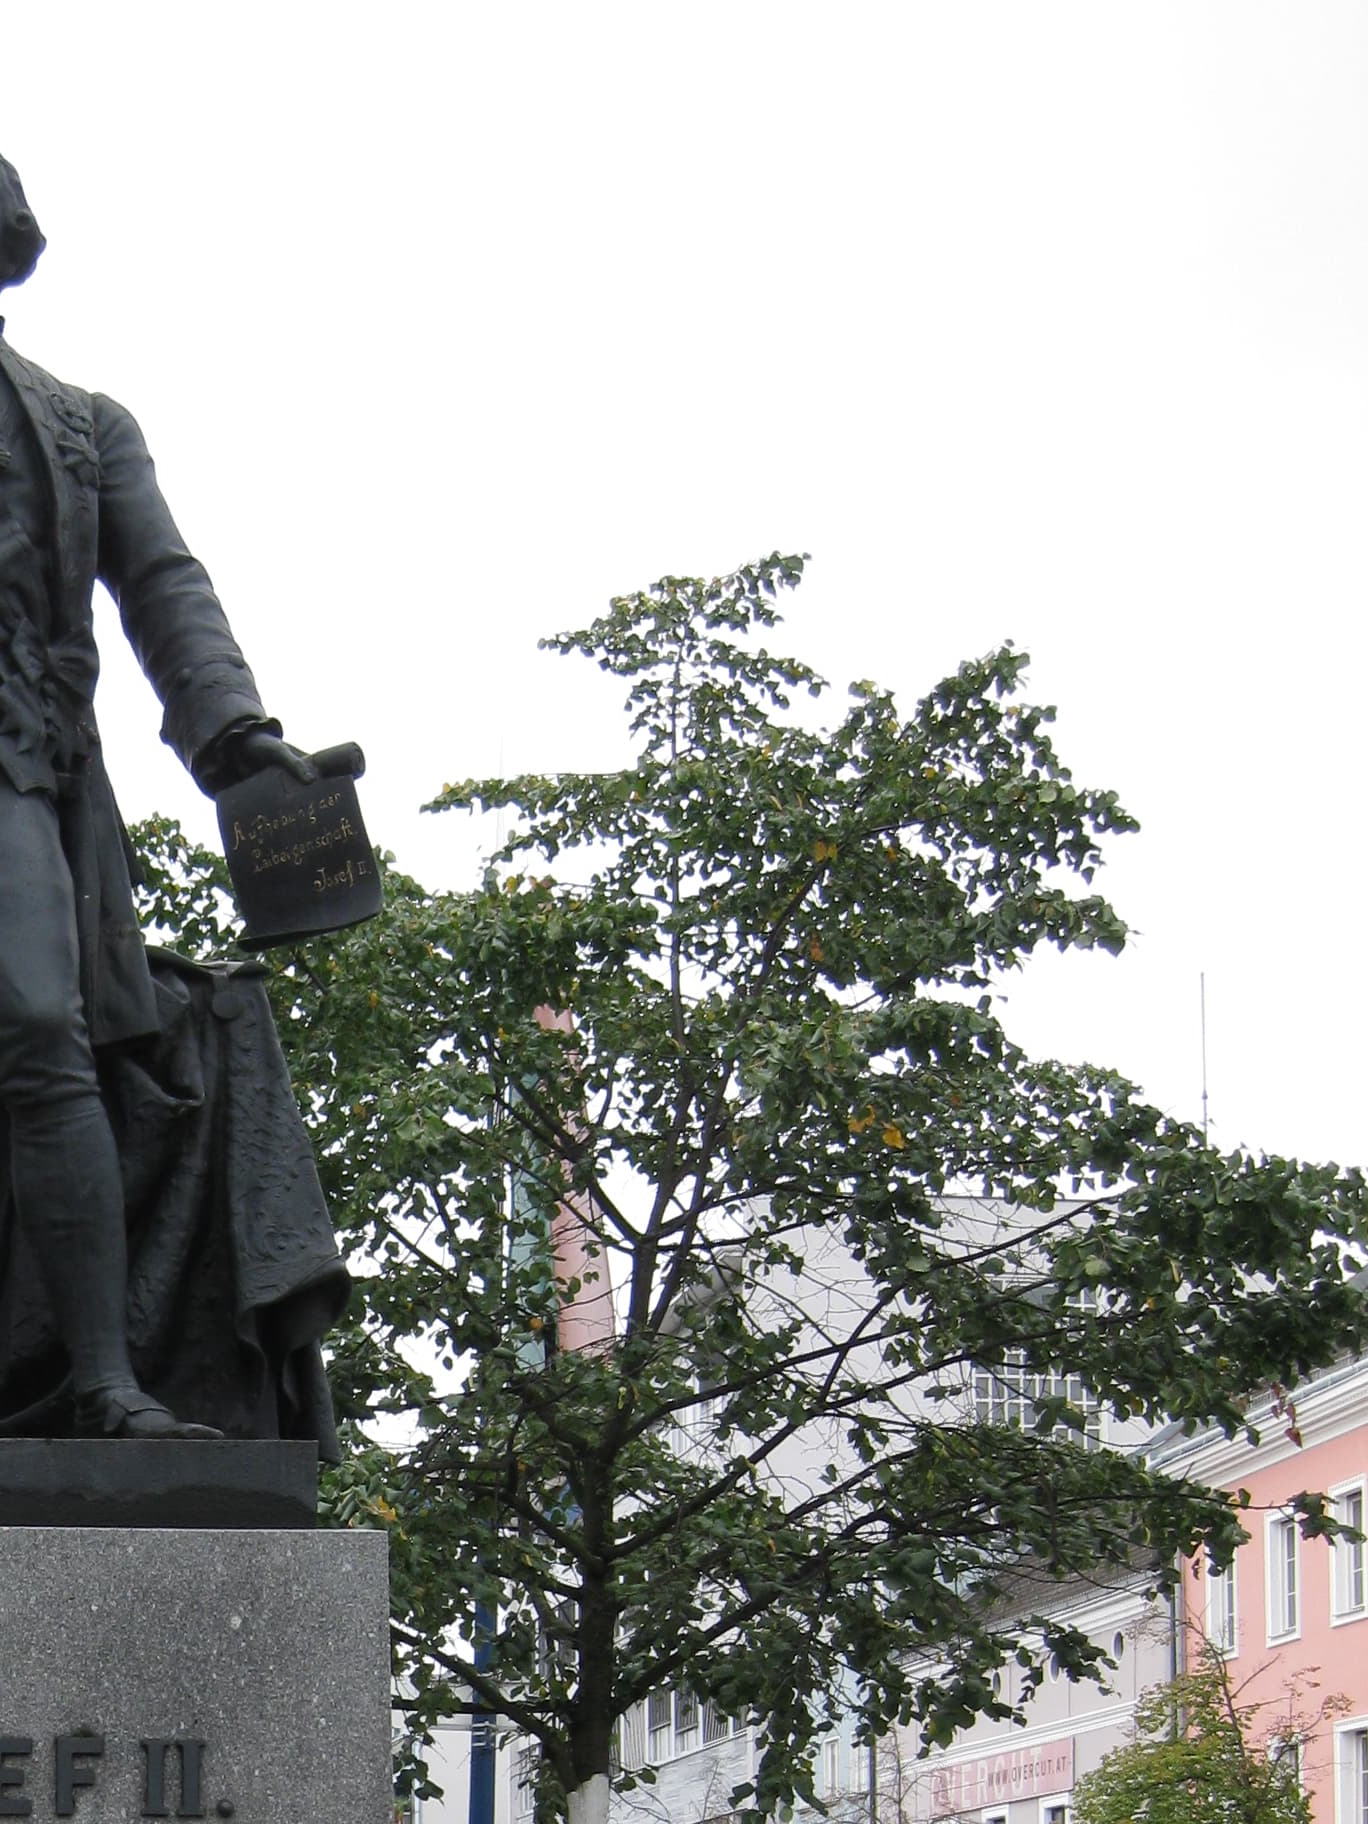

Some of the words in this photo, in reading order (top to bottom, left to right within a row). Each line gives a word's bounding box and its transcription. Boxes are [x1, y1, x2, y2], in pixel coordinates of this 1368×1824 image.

[314, 860, 355, 892] Josef
[141, 1736, 235, 1818] II.
[987, 1756, 1067, 1787] WWW.OVERCUT.AT
